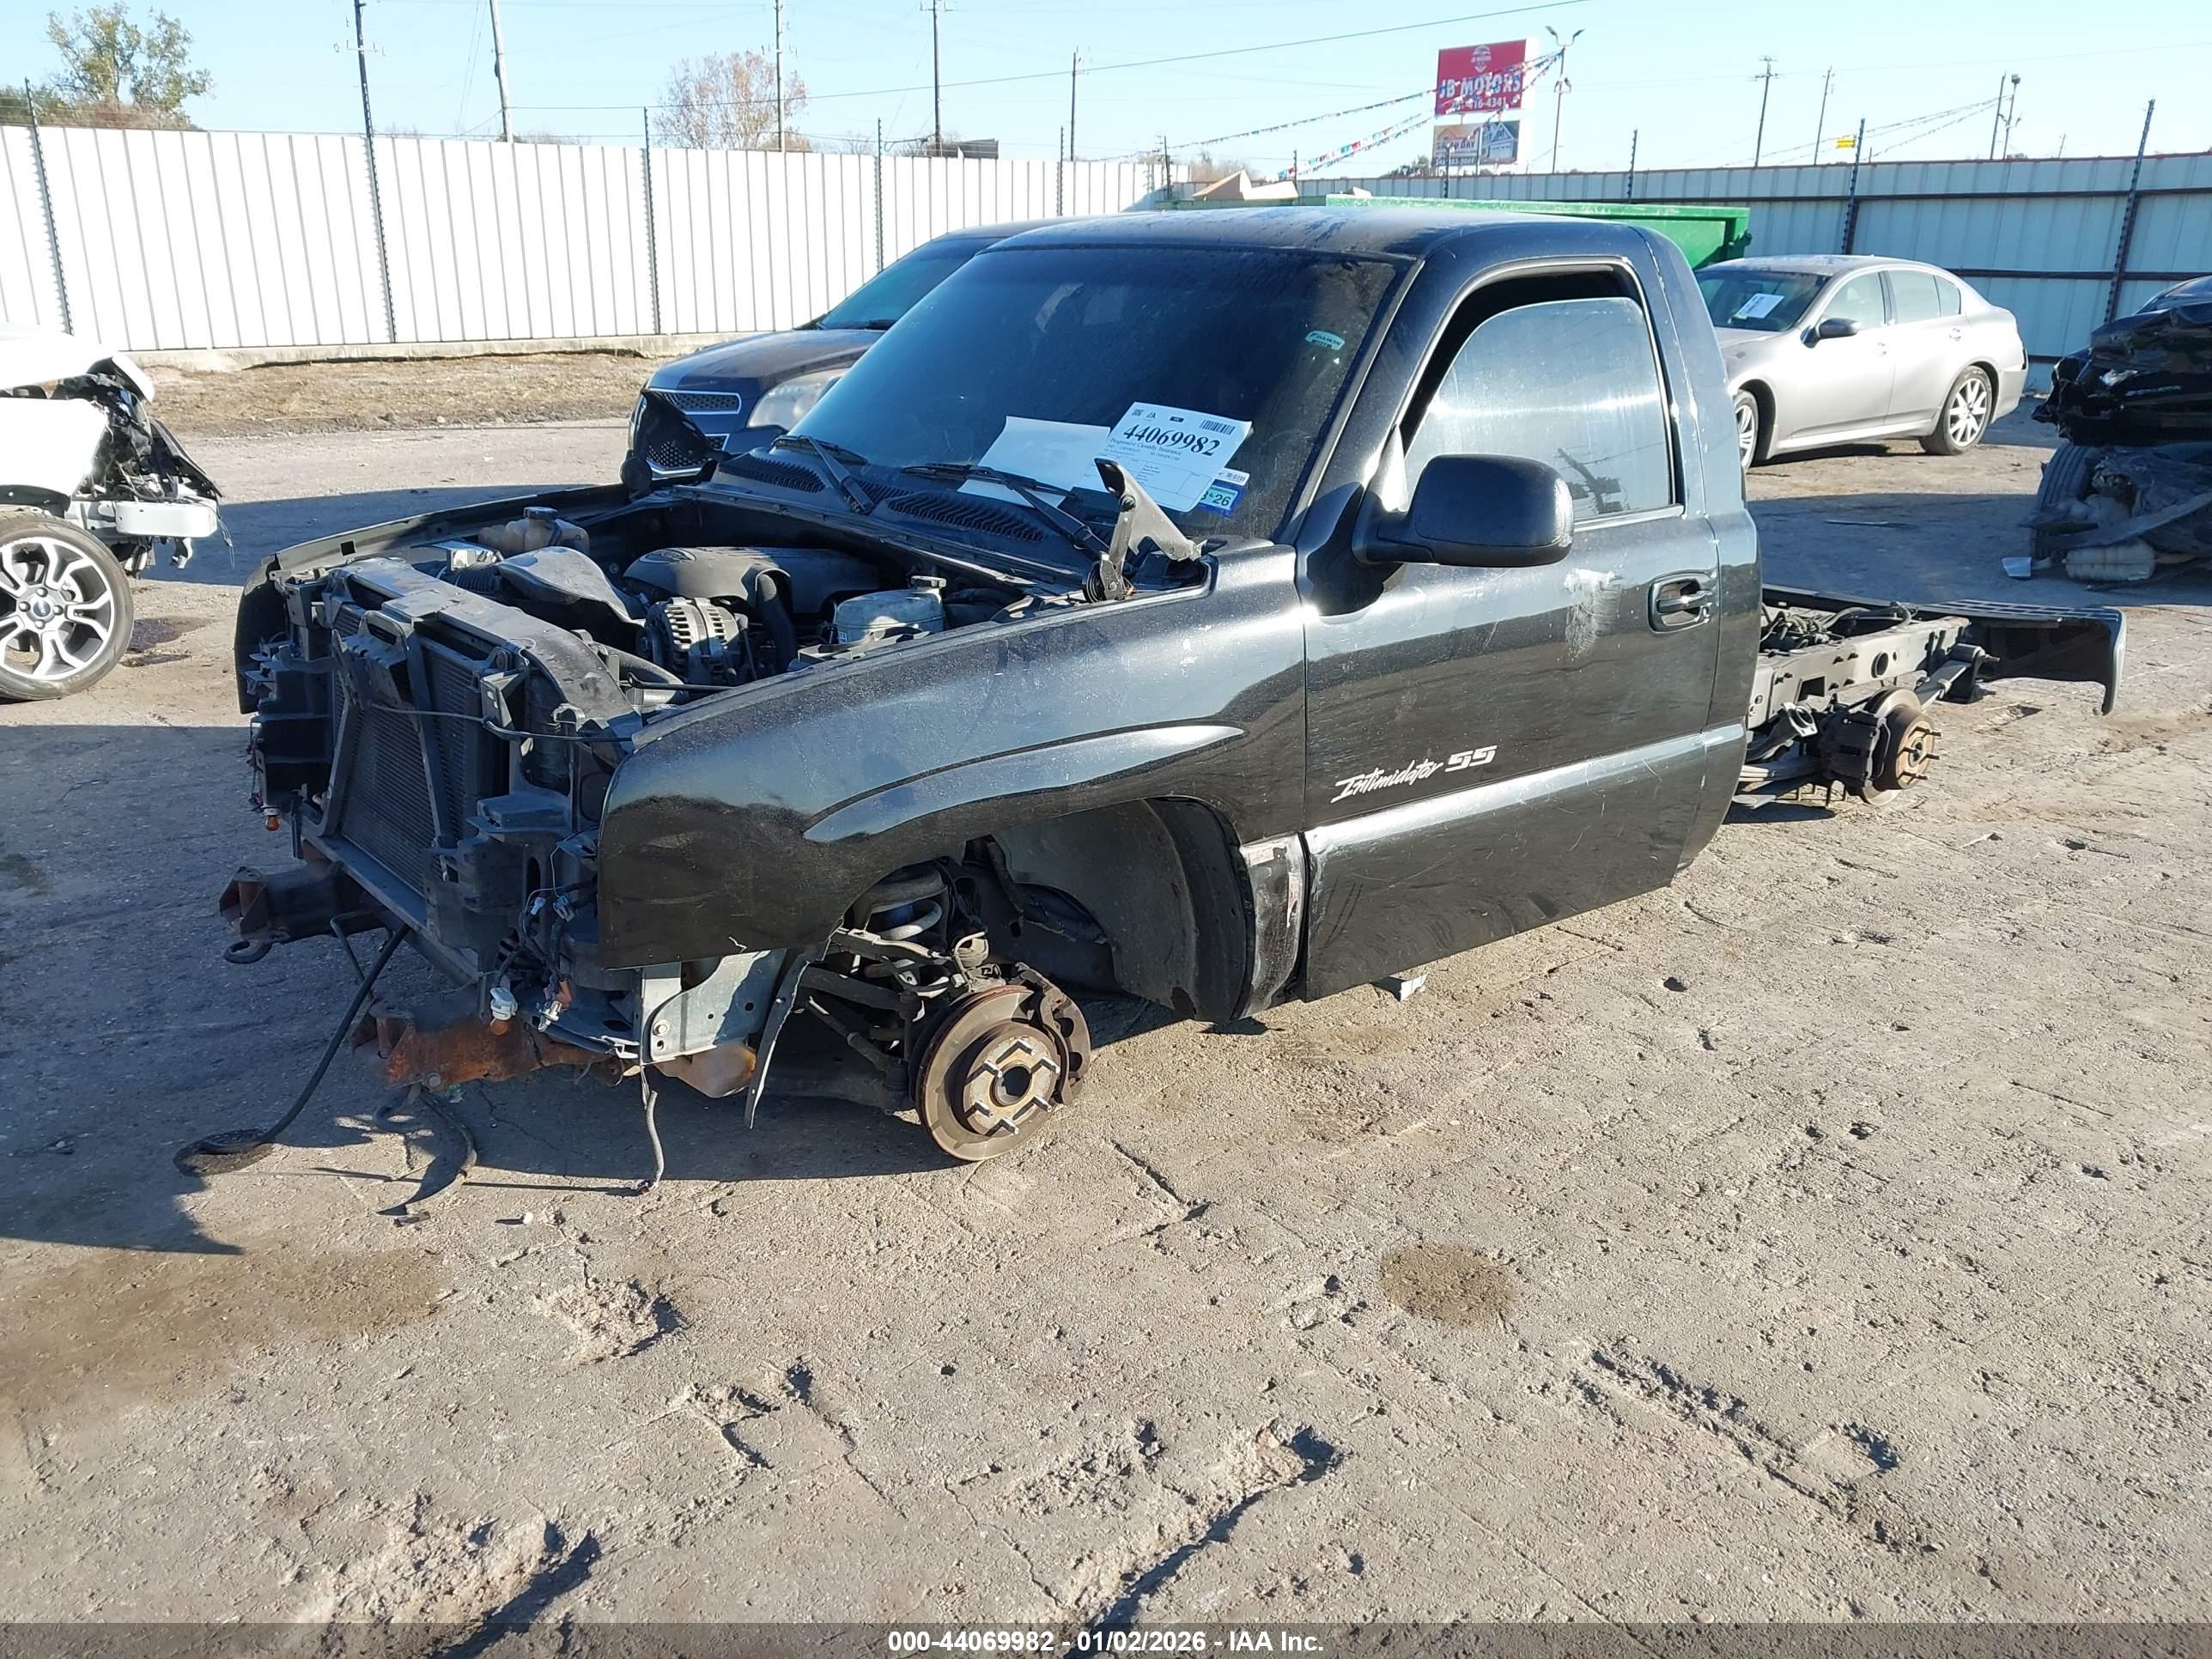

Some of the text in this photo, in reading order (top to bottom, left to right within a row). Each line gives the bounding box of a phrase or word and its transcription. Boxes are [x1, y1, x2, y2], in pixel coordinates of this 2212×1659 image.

[1439, 71, 1521, 99] JB MOTORS
[1123, 423, 1221, 456] 44069982
[1212, 494, 1231, 507] 26
[1330, 758, 1444, 804] Intimidator
